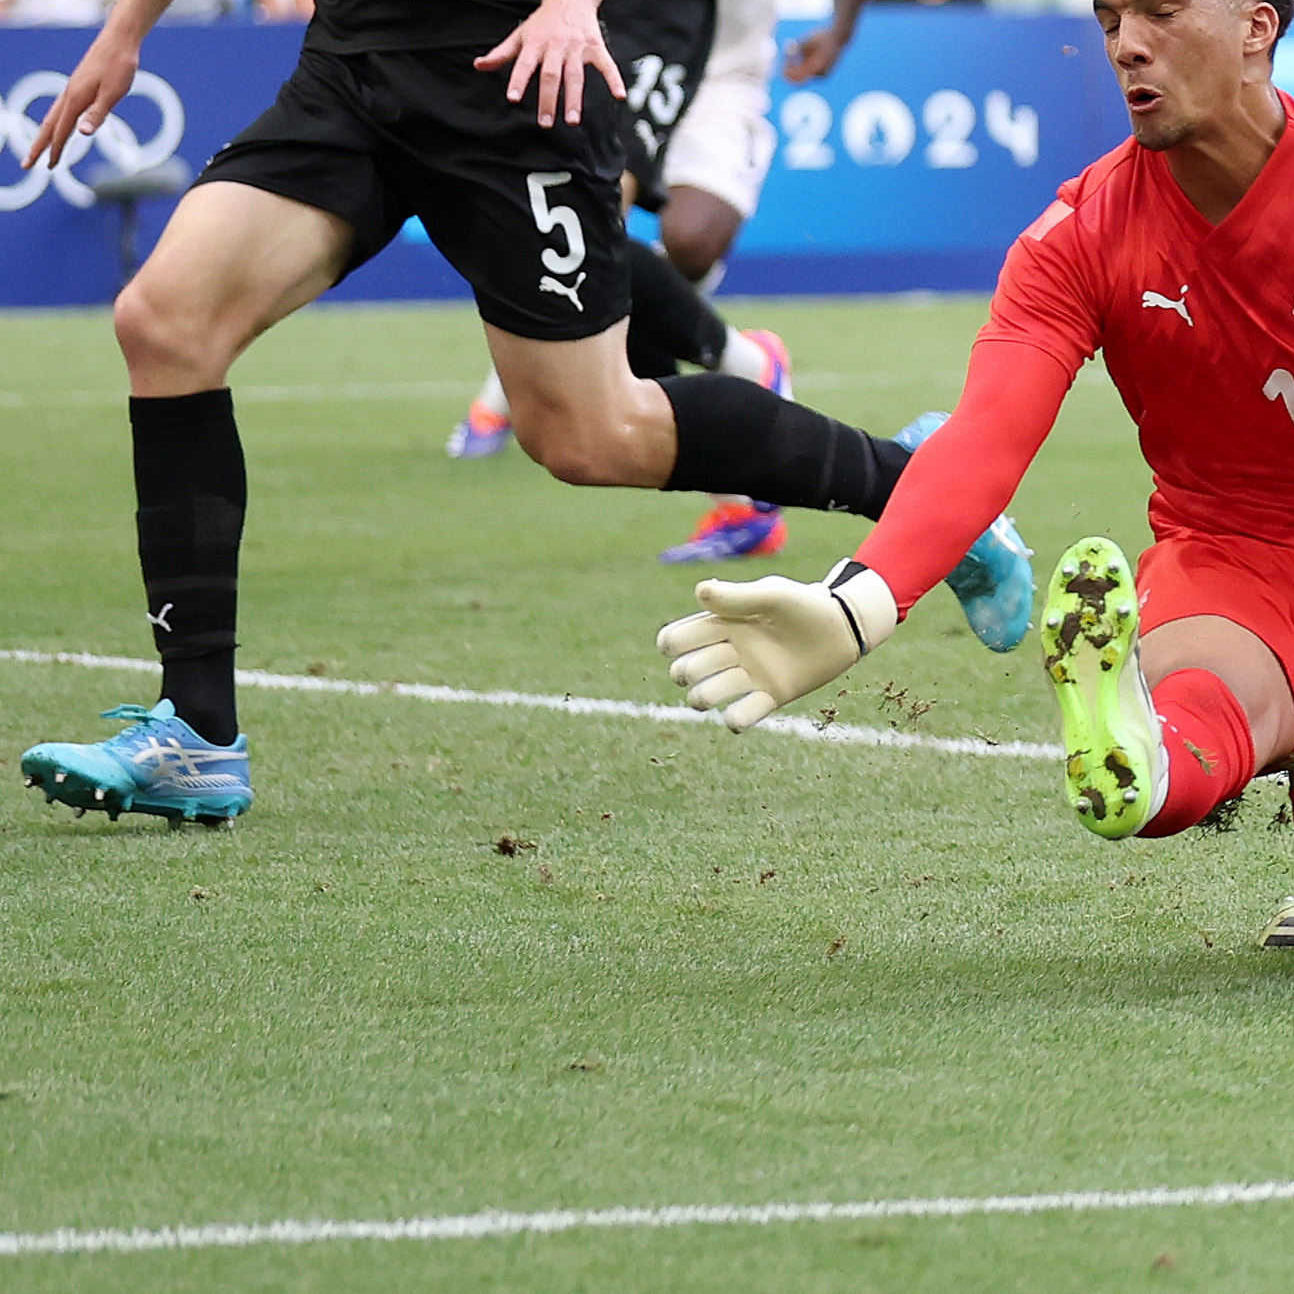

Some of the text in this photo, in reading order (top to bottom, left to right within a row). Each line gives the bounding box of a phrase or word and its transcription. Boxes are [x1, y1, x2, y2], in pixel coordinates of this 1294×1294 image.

[627, 54, 688, 126] 15
[780, 88, 1039, 171] 2024
[526, 171, 587, 275] 5
